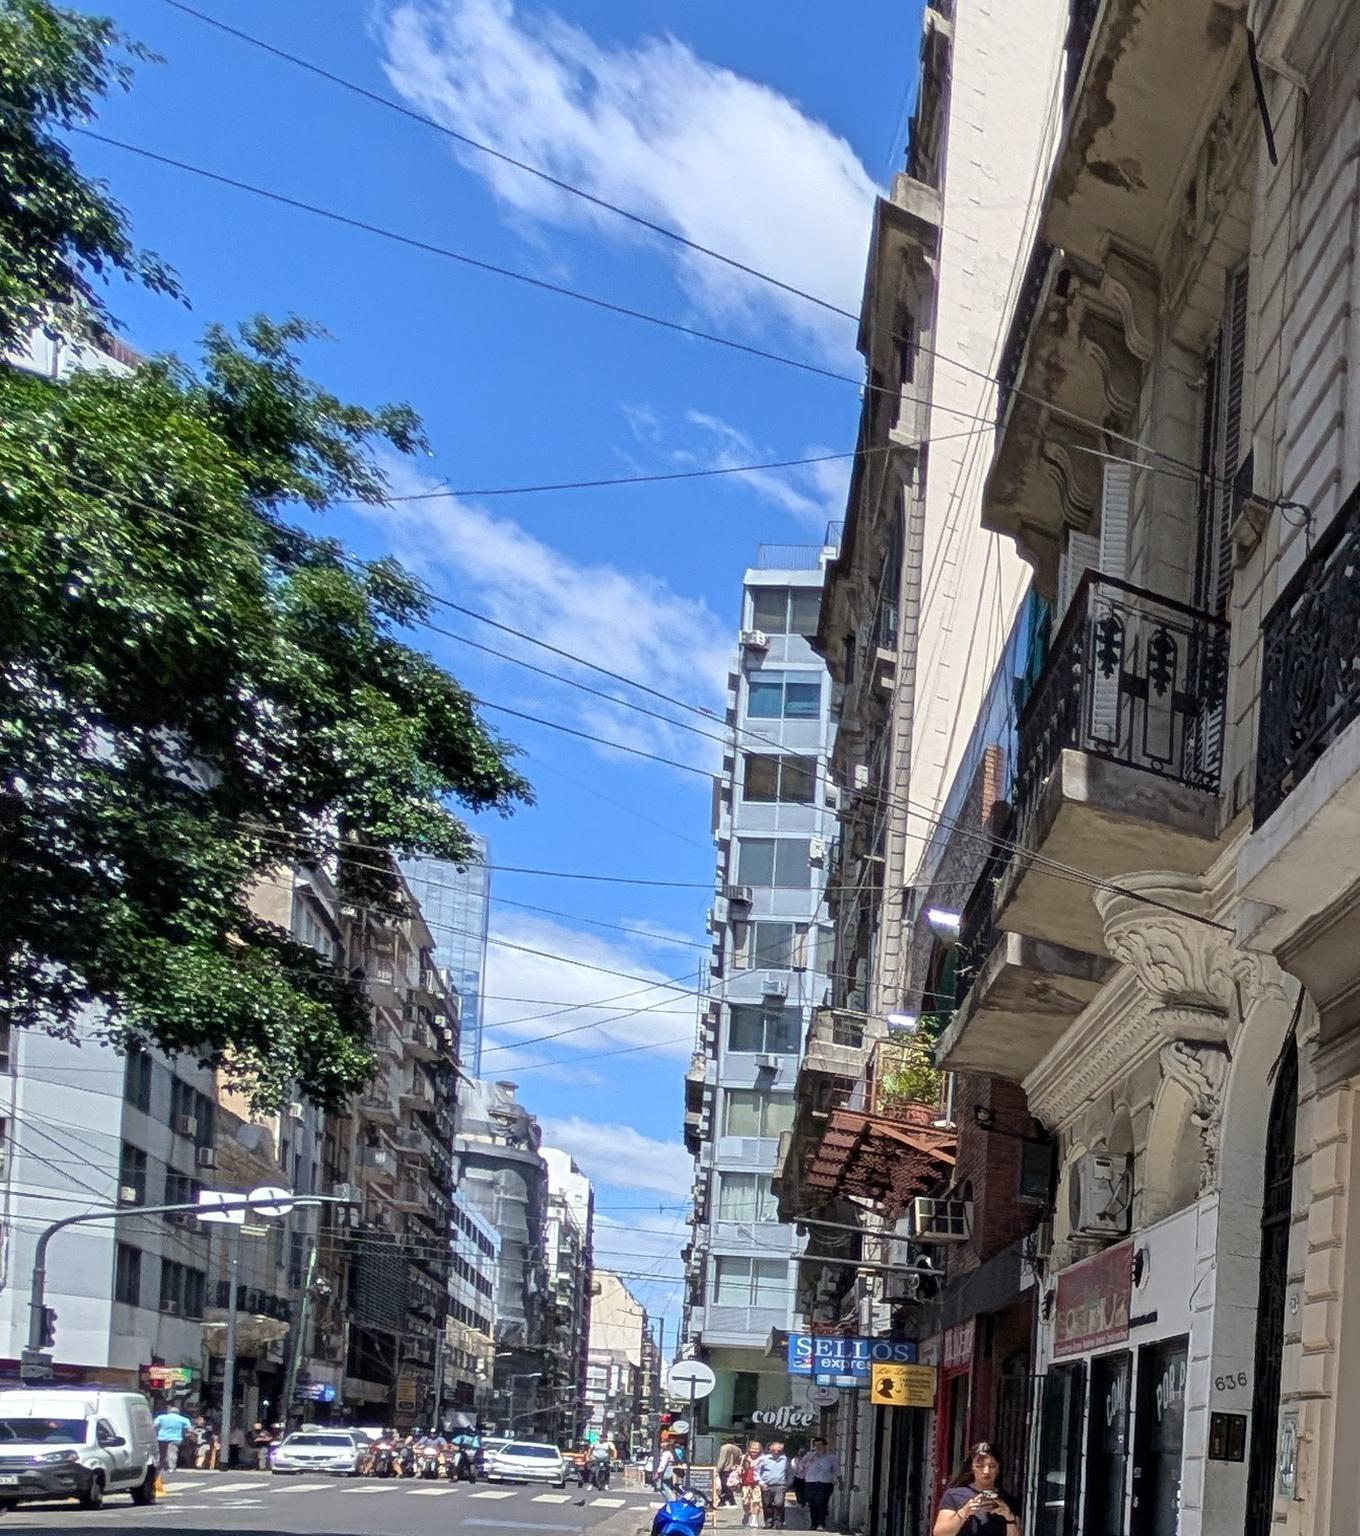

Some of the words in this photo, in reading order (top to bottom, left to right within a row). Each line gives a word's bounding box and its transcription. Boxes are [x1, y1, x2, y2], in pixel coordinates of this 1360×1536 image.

[796, 1337, 909, 1362] SELLOS
[1214, 1371, 1249, 1392] 636
[752, 1405, 813, 1431] coffee
